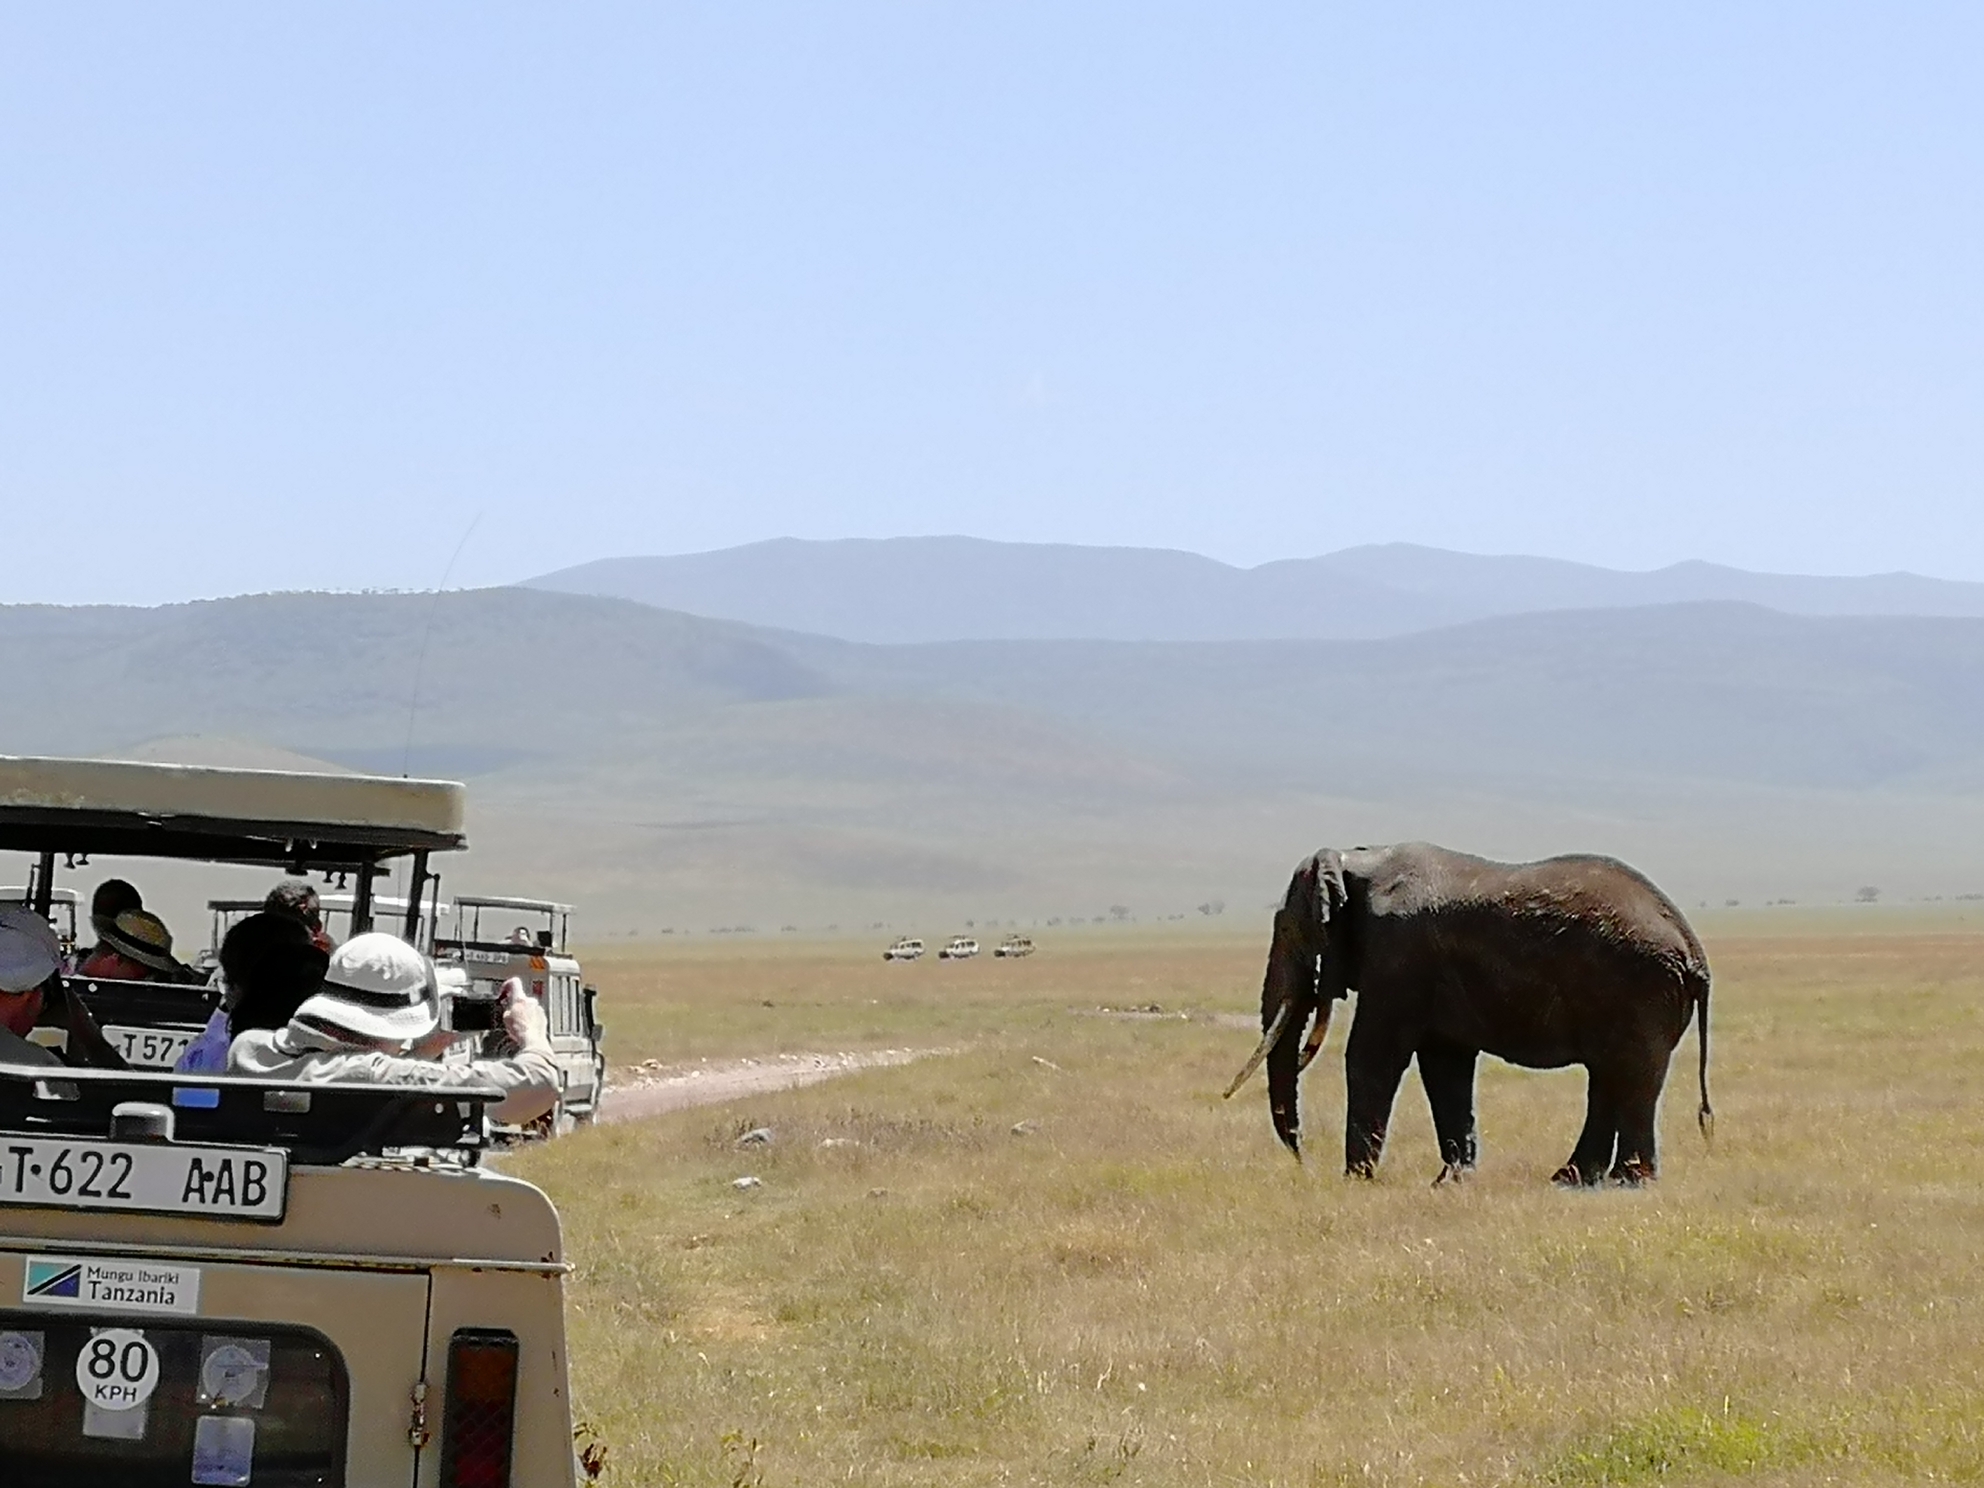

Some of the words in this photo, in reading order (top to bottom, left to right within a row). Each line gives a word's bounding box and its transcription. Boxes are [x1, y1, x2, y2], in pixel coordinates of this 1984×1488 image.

[122, 1033, 137, 1059] T
[182, 1157, 267, 1206] AAB
[87, 1266, 133, 1283] Mungu
[138, 1270, 179, 1285] Ibariki
[88, 1280, 175, 1305] Tanzania
[88, 1338, 149, 1383] 80
[94, 1384, 137, 1402] KPH
